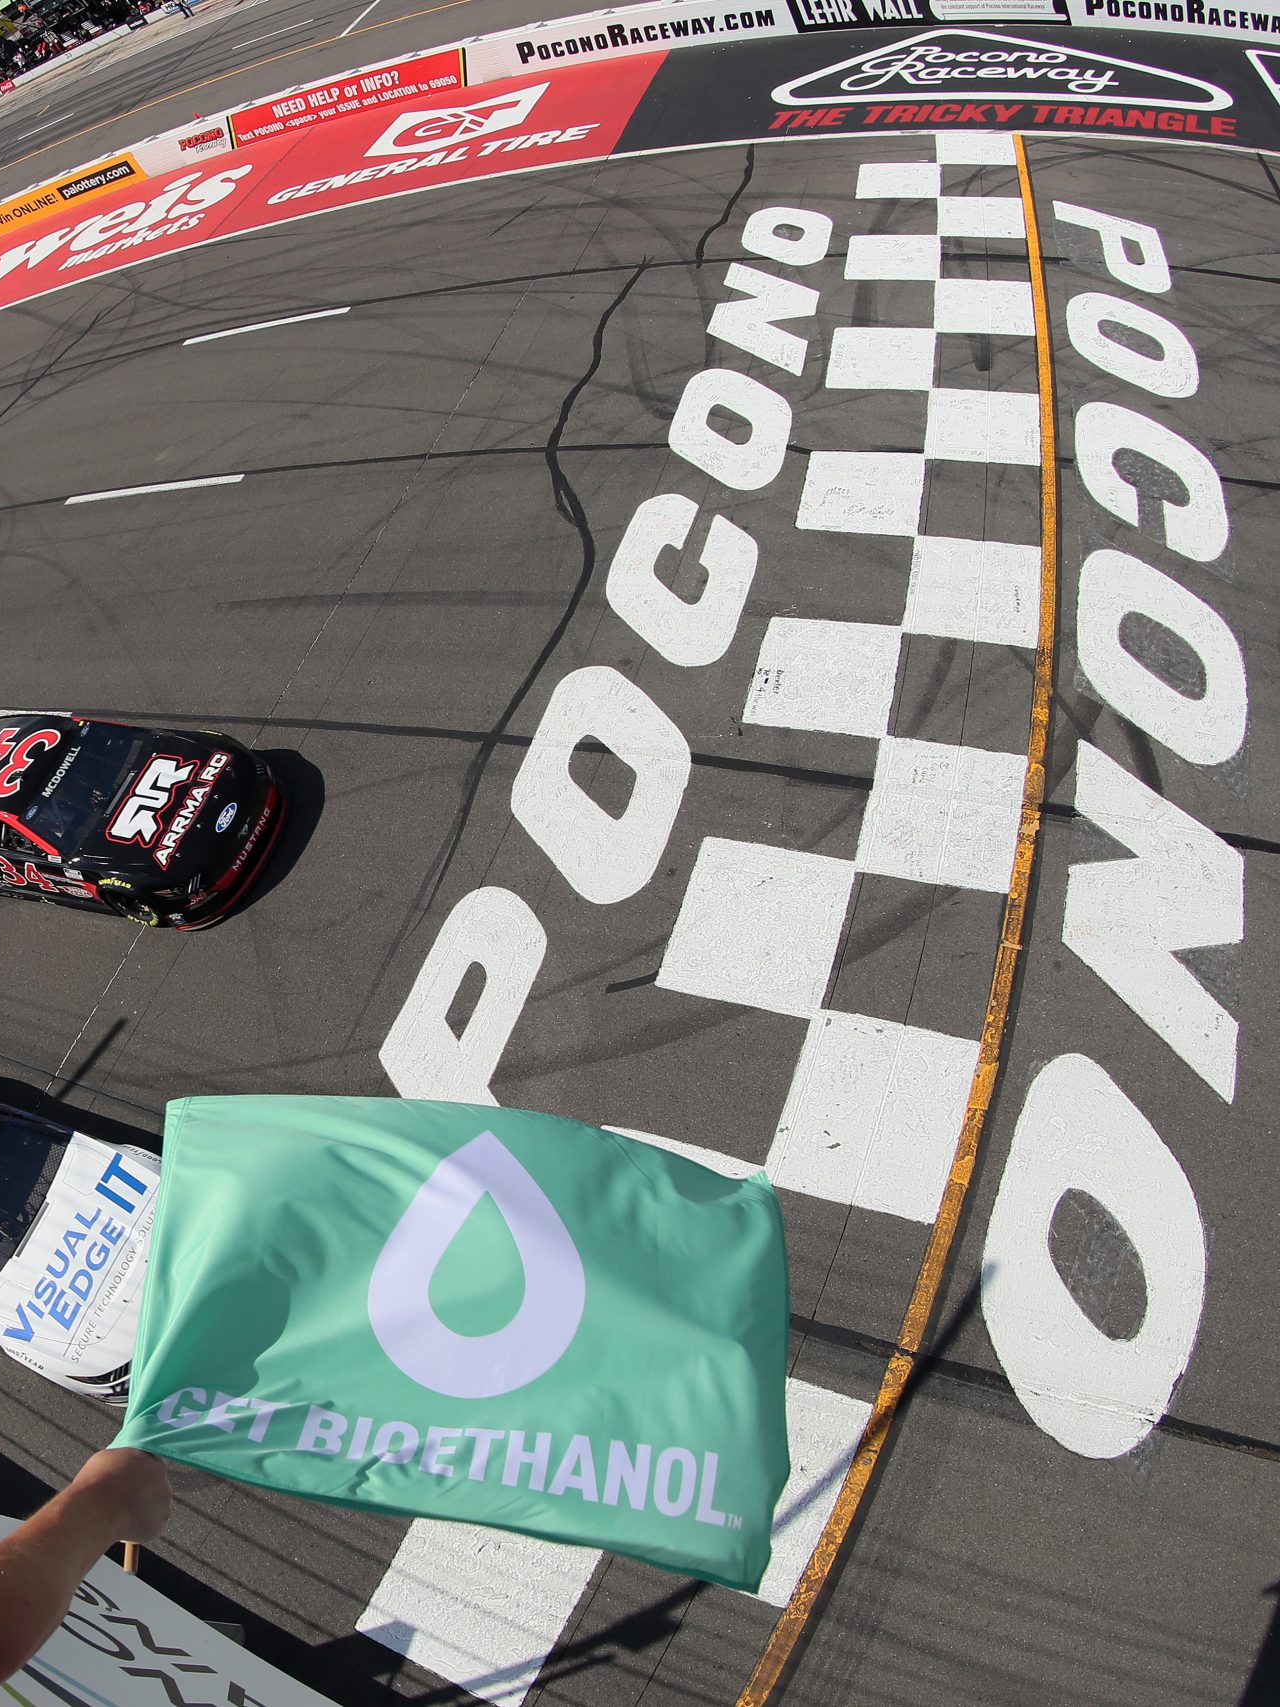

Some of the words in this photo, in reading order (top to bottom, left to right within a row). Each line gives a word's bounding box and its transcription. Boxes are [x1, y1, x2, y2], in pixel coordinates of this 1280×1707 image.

[841, 54, 1119, 93] Raceway
[906, 46, 1068, 66] Pocono
[238, 128, 254, 142] Text
[255, 121, 285, 137] POCONO
[318, 107, 337, 120] your
[337, 99, 362, 113] ISSUE
[362, 94, 379, 108] and
[378, 84, 418, 103] LOCATION
[418, 82, 429, 92] to
[429, 74, 458, 89] 69050
[272, 95, 306, 118] NEED
[309, 87, 340, 109] HELP
[344, 83, 358, 98] or
[360, 70, 400, 93] INFO?
[768, 107, 854, 129] THE
[863, 104, 1024, 125] TRICKY
[1032, 105, 1237, 138] TRIANGLE
[178, 127, 224, 151] POCONO
[267, 148, 477, 205] GENERAL
[475, 122, 601, 158] TIRE
[11, 192, 59, 218] ONLINE!
[62, 164, 130, 199] palottery.com
[57, 212, 206, 272] markets
[378, 206, 835, 1106] POCONO
[42, 746, 81, 797] MCDOWELL
[157, 784, 211, 865] ARRMA
[233, 807, 272, 872] MUSTANG
[980, 200, 1248, 1461] POCONO
[3, 1207, 102, 1343] VISUAL
[95, 1152, 148, 1214] IT
[48, 1216, 126, 1331] EDGE
[71, 1321, 97, 1363] SECURE
[94, 1249, 139, 1320] TECHNOLOGY
[156, 1386, 299, 1443] GET
[295, 1403, 727, 1527] BIOETHANOL
